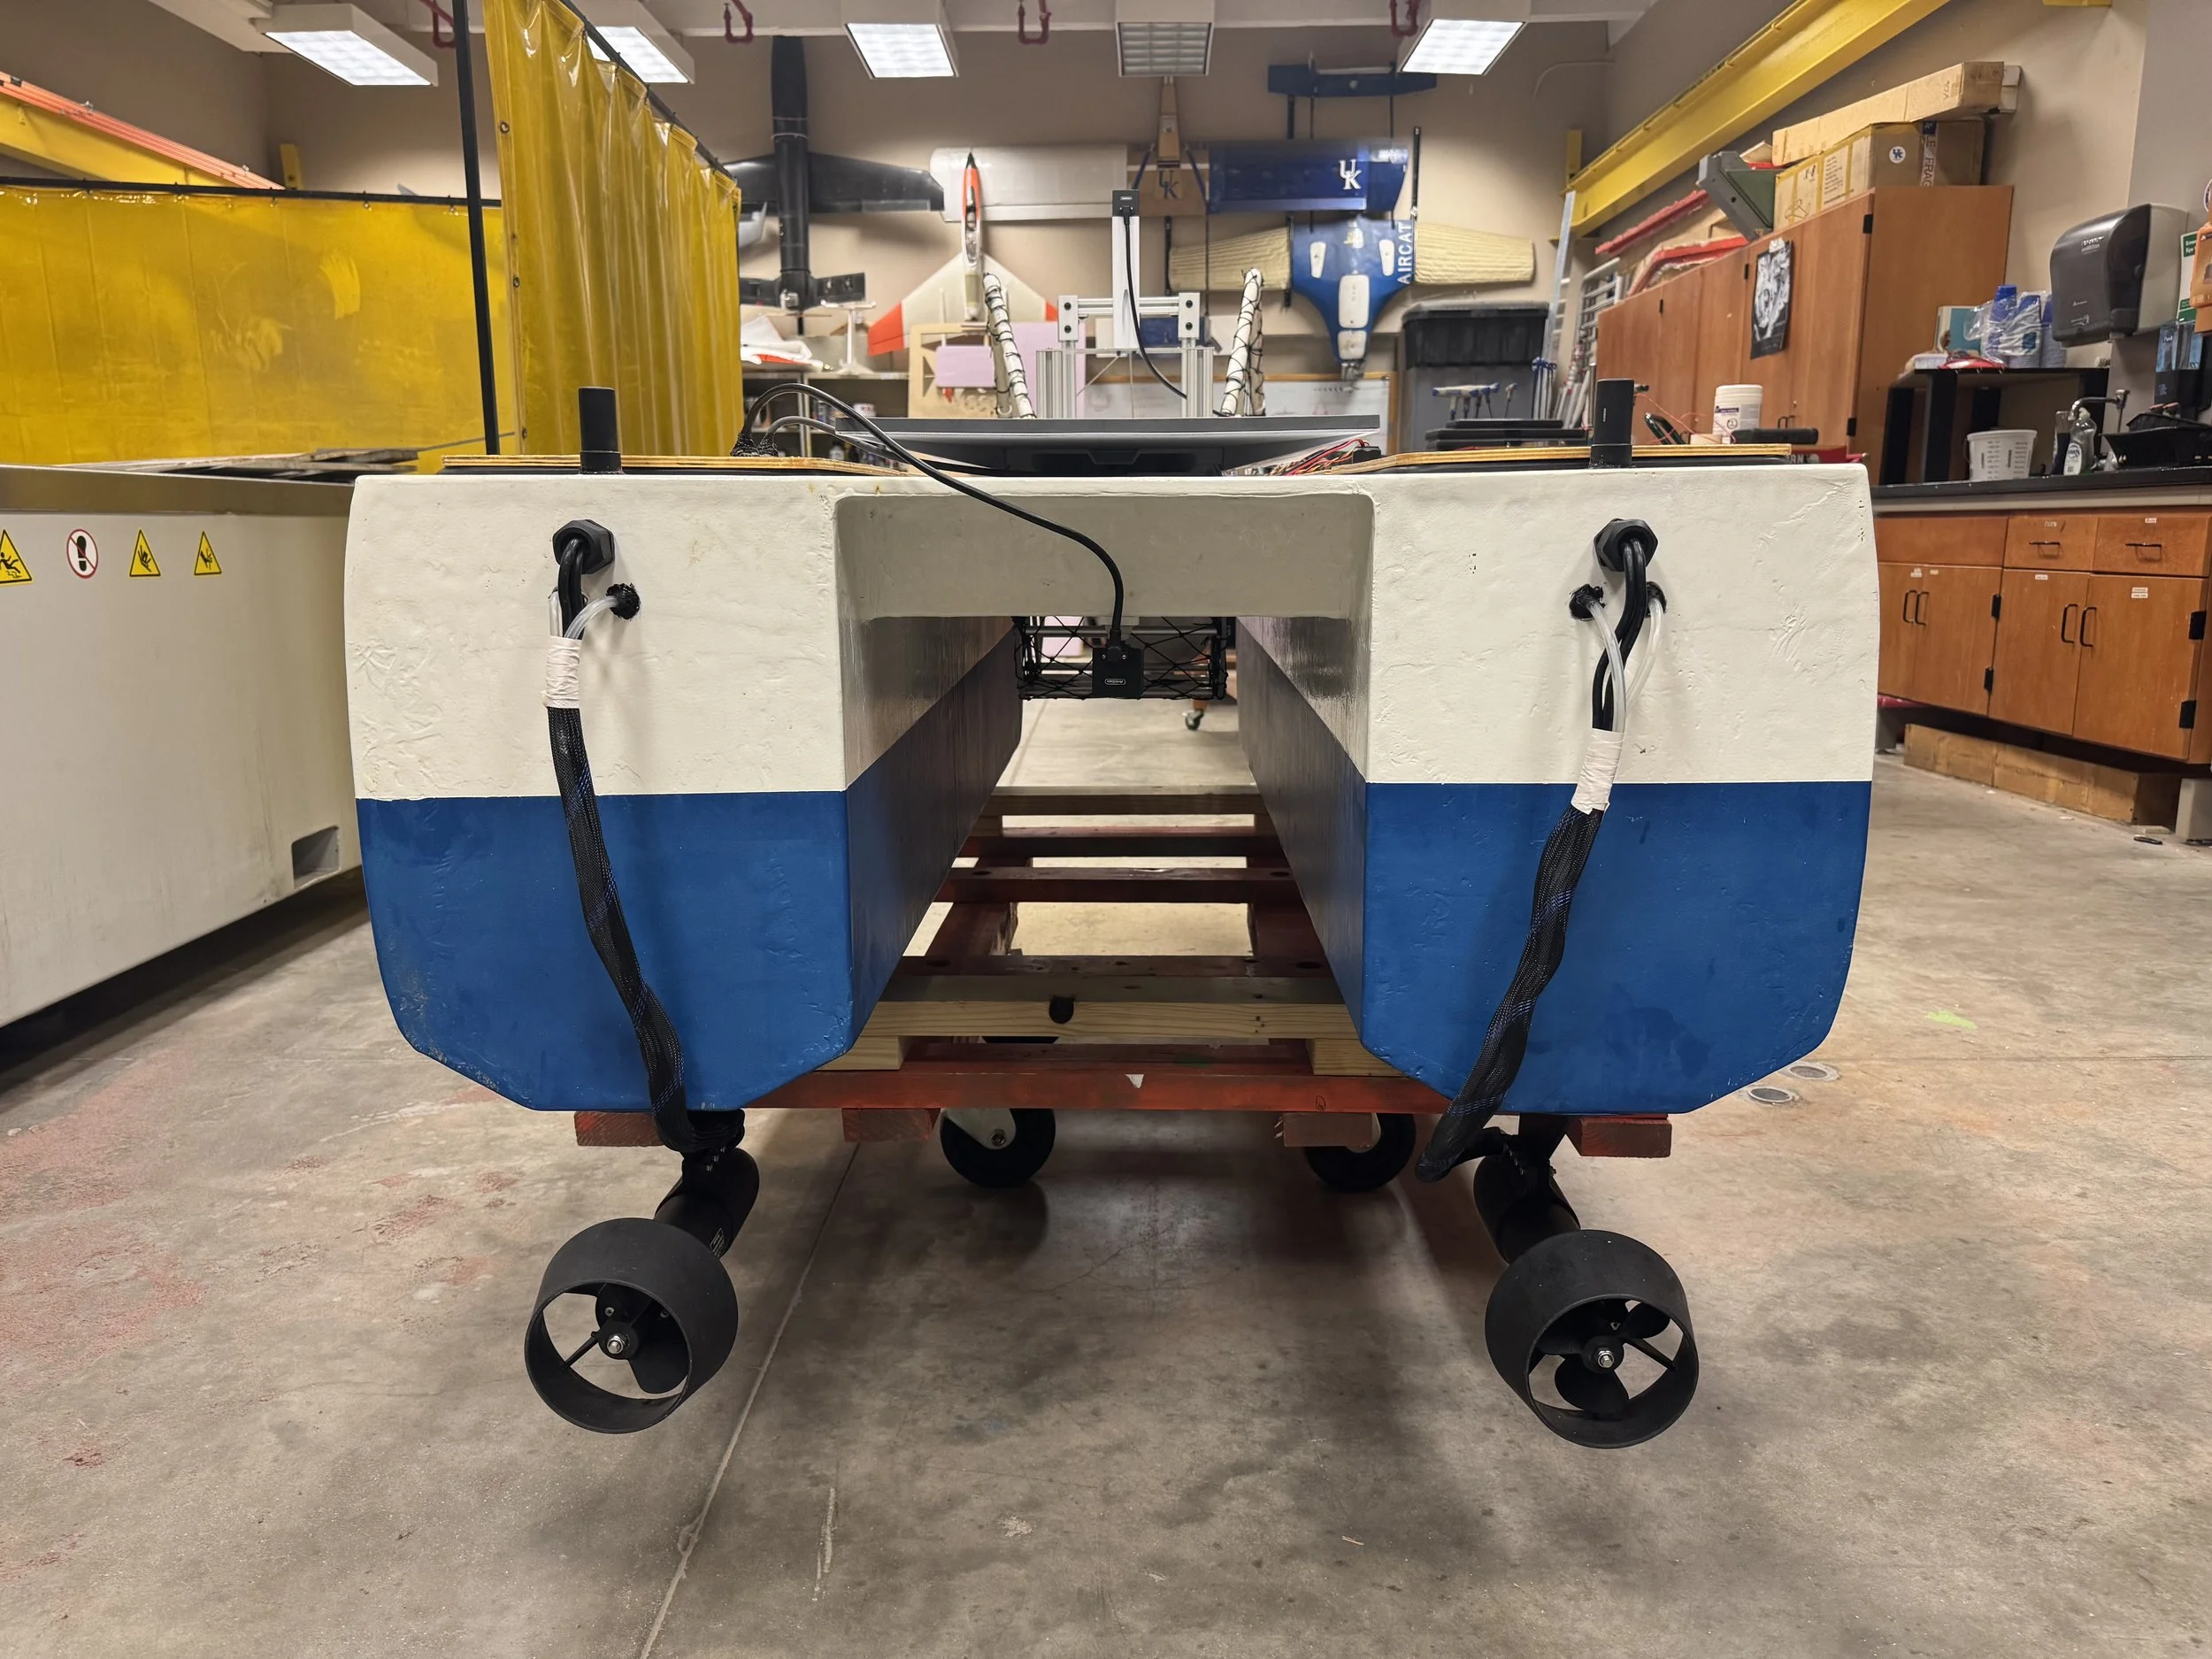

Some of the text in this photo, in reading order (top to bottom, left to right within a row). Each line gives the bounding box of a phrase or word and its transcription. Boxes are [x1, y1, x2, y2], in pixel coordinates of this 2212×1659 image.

[1159, 169, 1180, 199] UK
[1339, 158, 1363, 190] UK
[1397, 222, 1413, 285] AIRCAT
